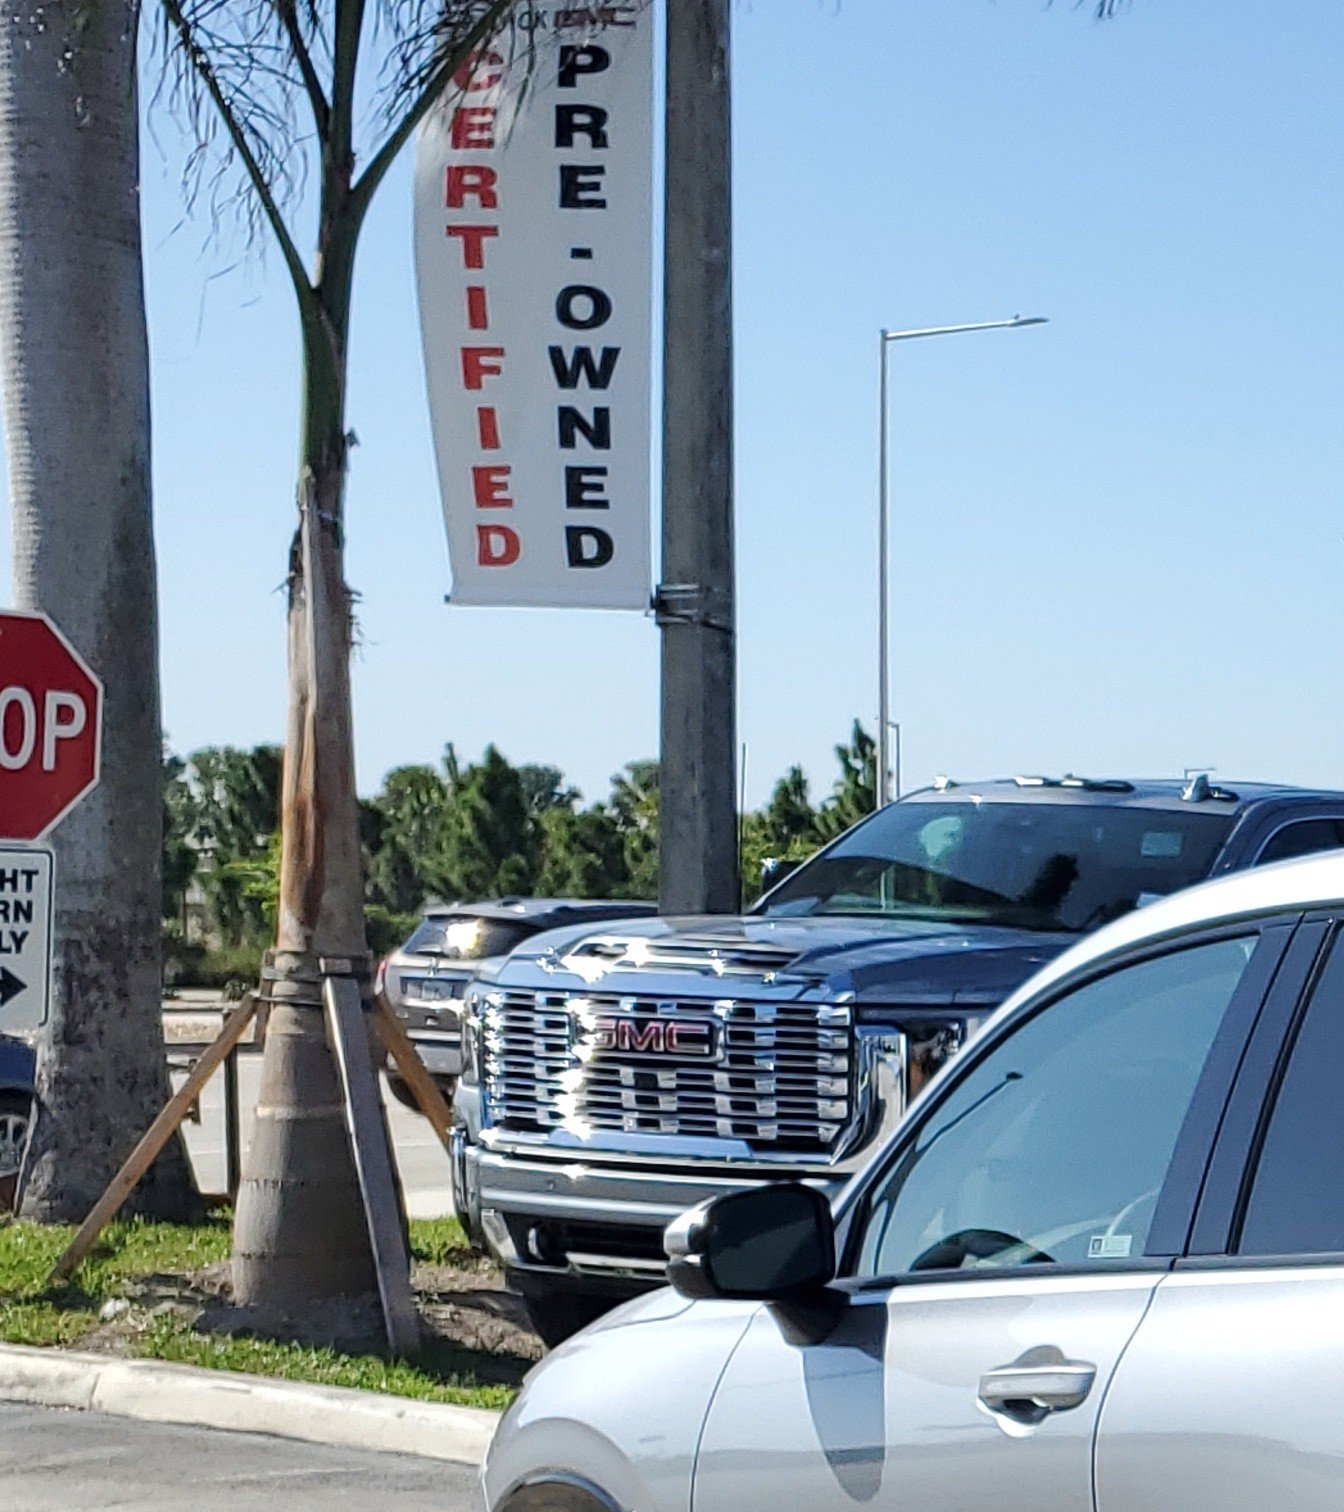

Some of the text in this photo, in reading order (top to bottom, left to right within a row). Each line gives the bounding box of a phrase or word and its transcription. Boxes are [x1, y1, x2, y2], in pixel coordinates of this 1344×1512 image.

[445, 50, 521, 568] CERTIFIED
[548, 44, 621, 569] PRE-OWNED
[0, 686, 87, 771] OP
[0, 868, 39, 893] HT
